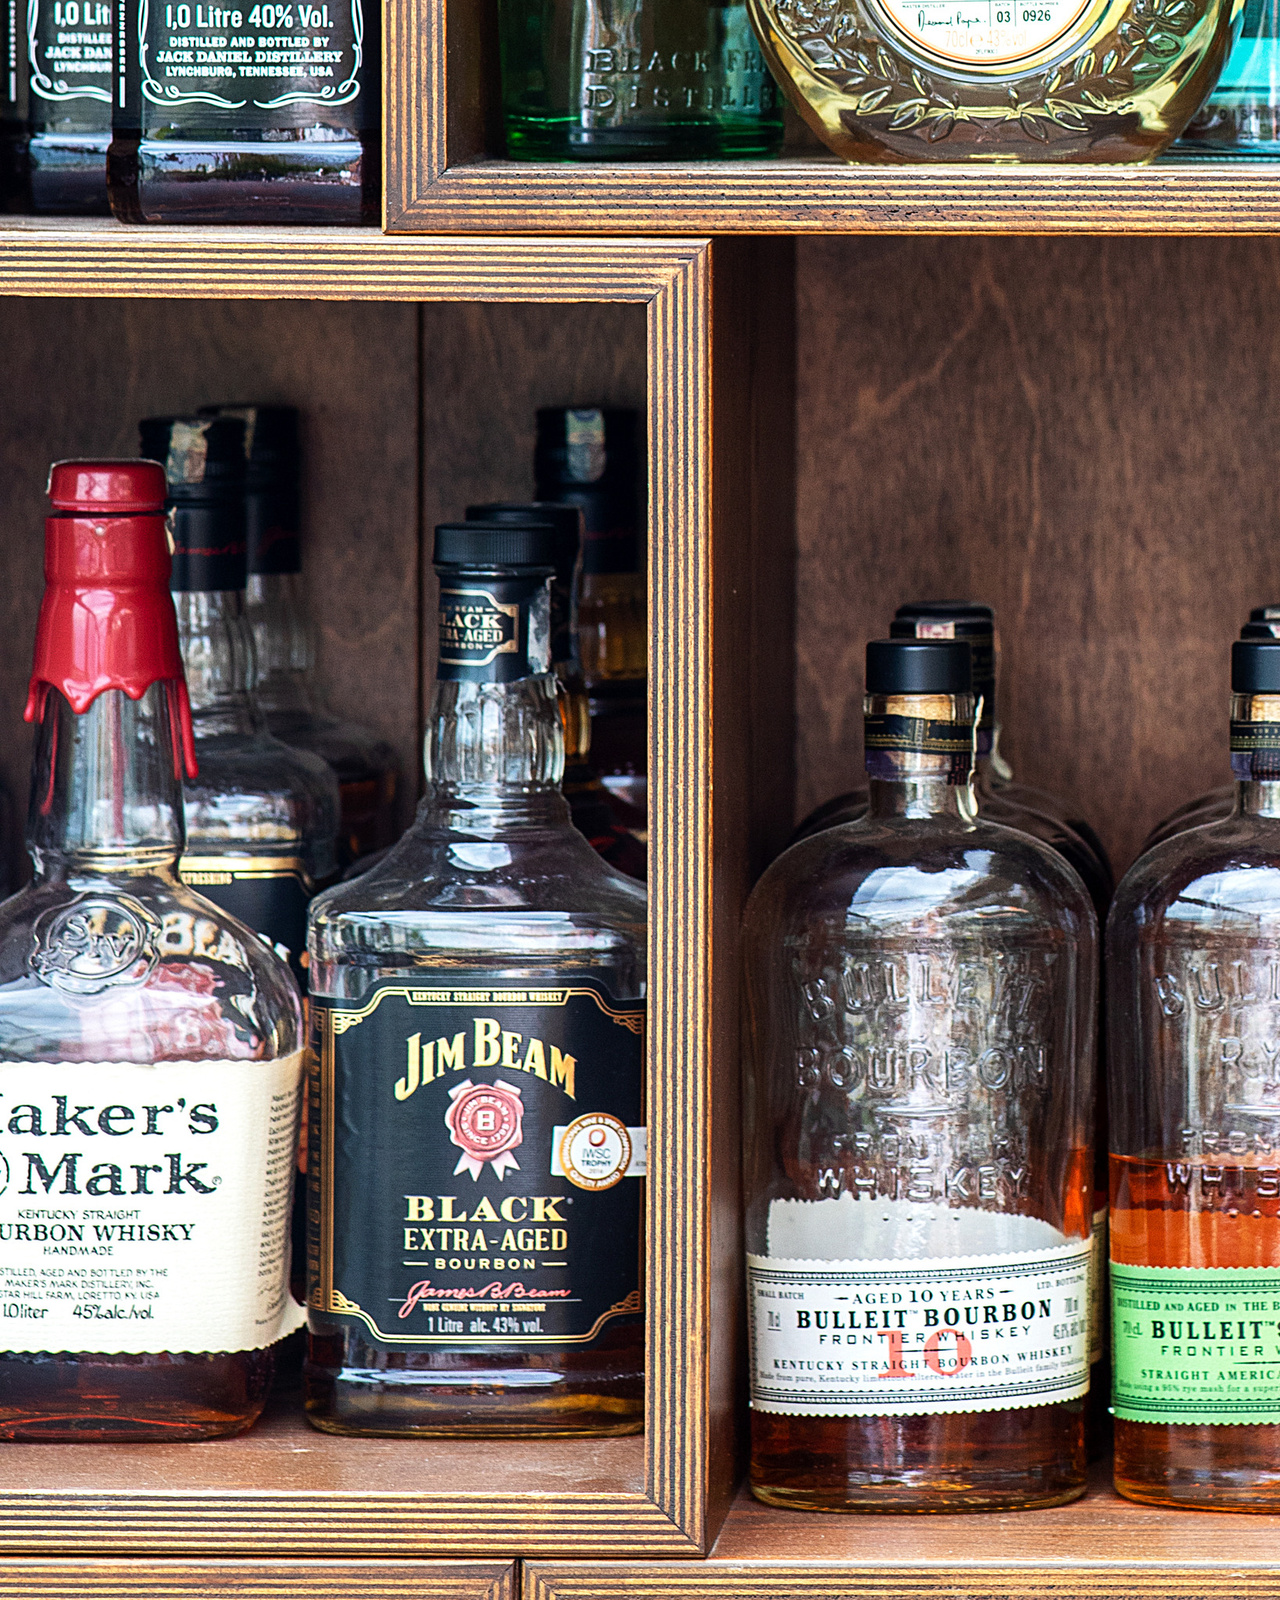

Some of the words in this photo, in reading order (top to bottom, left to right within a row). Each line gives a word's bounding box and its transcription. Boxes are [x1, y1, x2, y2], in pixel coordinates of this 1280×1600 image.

[197, 3, 243, 29] Litre
[248, 4, 294, 29] 40%
[297, 4, 334, 29] Vol.
[996, 10, 1011, 23] 03
[1022, 8, 1052, 22] 0926
[169, 36, 227, 49] DISTILLED
[230, 36, 255, 49] AND
[258, 36, 310, 49] BOTTLED
[314, 36, 330, 49] BY
[156, 50, 193, 64] JACK
[196, 50, 252, 64] DANIEL
[255, 50, 343, 64] DISTILLERY
[165, 66, 235, 79] LYNCHBURG,
[239, 66, 306, 79] TENNESSEE,
[310, 66, 334, 78] USA
[394, 1031, 467, 1102] JIM
[472, 1017, 579, 1102] BEAM
[0, 1093, 220, 1137] aker's
[582, 1146, 611, 1160] IWSC
[581, 1159, 612, 1168] TROPHY
[18, 1151, 217, 1197] Mark
[17, 1209, 79, 1221] KENTUCKY
[82, 1209, 140, 1221] STRAIGHT
[404, 1195, 567, 1223] BLACK
[0, 1223, 88, 1242] URBON
[93, 1223, 195, 1242] WHISKY
[403, 1227, 568, 1253] EXTRA-AGED
[43, 1245, 114, 1257] HANDMADE
[434, 1257, 536, 1270] BOURBON
[852, 1292, 903, 1305] AGED
[909, 1289, 933, 1304] 10
[940, 1287, 995, 1302] YEARS
[797, 1309, 909, 1330] BULLEIT
[924, 1299, 1052, 1328] BOURBON
[438, 1316, 464, 1333] Litre
[469, 1316, 490, 1333] alc.
[492, 1317, 519, 1333] 43%
[522, 1317, 544, 1333] vol.
[1152, 1320, 1264, 1340] BULLEIT
[819, 1332, 926, 1345] FRONTIER
[936, 1324, 1033, 1343] WHISKEY
[774, 1358, 845, 1372] KENTUCKY
[852, 1358, 930, 1372] STRAIGHT
[938, 1353, 1010, 1369] BOURBON
[1017, 1345, 1074, 1363] WHISKEY
[1161, 1345, 1264, 1357] FRONTIER
[1141, 1368, 1210, 1381] STRAIGHT
